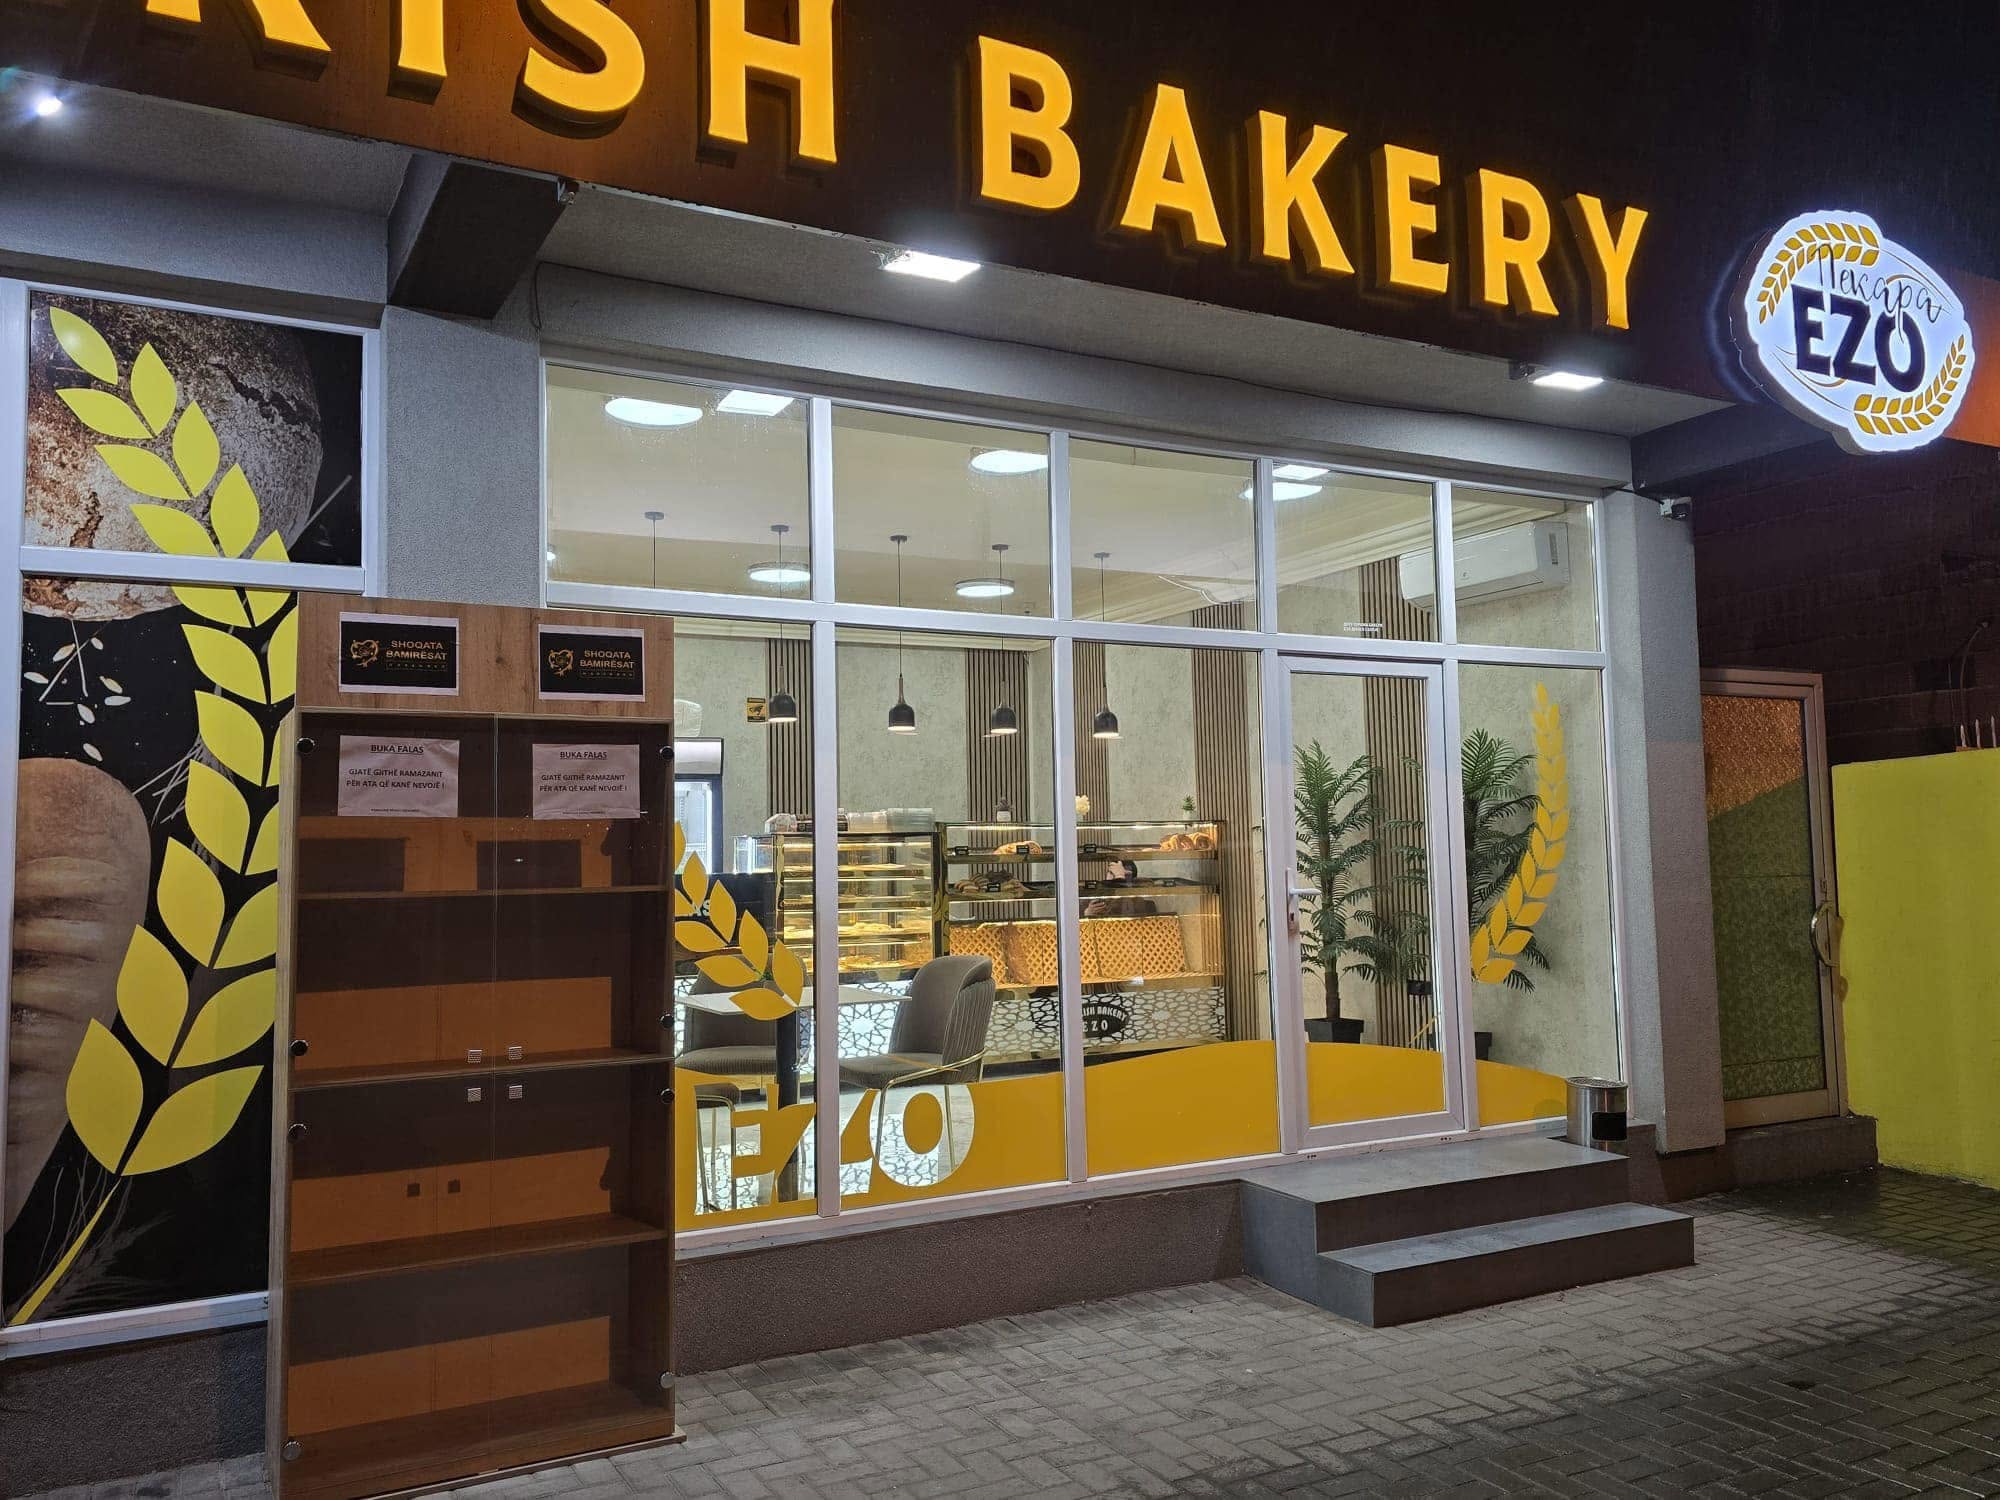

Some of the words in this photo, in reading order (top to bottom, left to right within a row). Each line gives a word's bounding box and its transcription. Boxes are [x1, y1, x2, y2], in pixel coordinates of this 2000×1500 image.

[978, 35, 1649, 329] BAKERY
[1811, 244, 1943, 343] Пекара
[1790, 284, 1926, 393] EZO
[391, 640, 444, 650] SHOQATA
[584, 650, 631, 659] SHOQATA
[370, 744, 395, 753] BUKA
[397, 745, 424, 754] FALAS
[559, 751, 582, 759] BUKA
[583, 751, 608, 759] FALAS
[399, 770, 443, 778] RAMAZANIT
[1097, 1006, 1128, 1022] BAKERY
[1082, 1019, 1109, 1032] EZO
[694, 1083, 976, 1217] EZO
